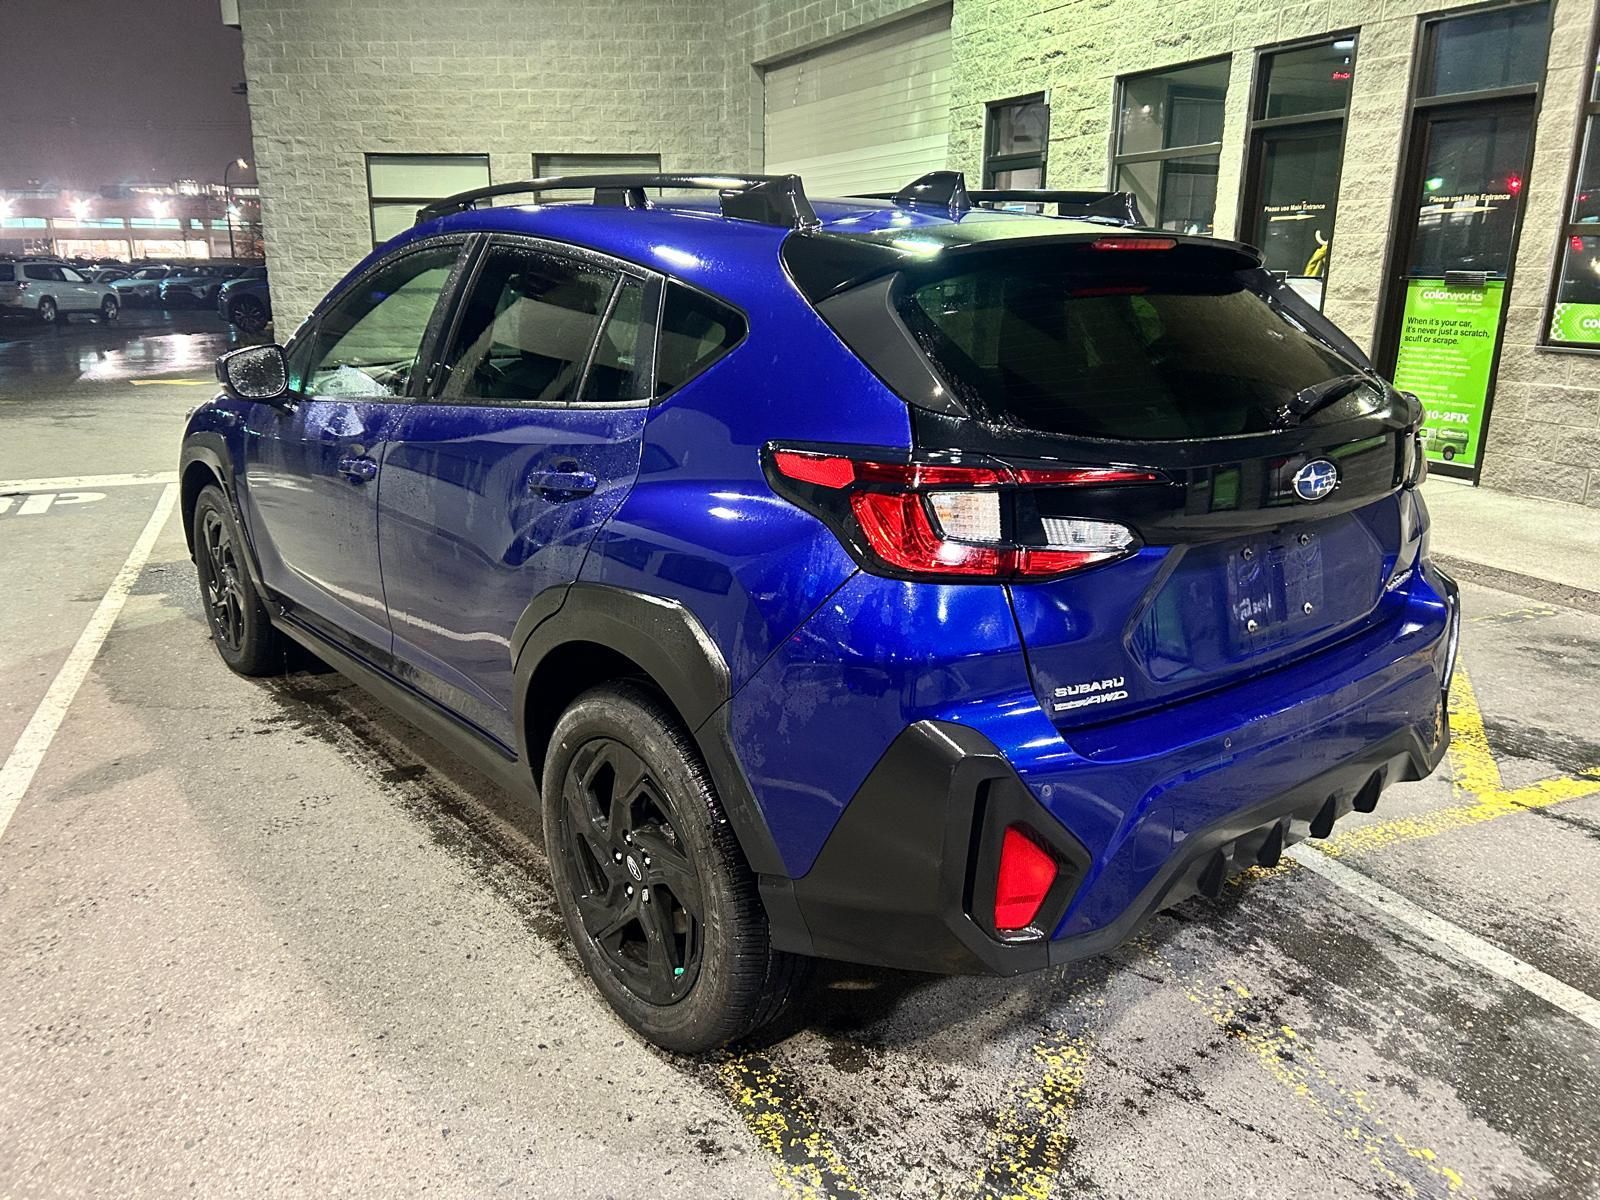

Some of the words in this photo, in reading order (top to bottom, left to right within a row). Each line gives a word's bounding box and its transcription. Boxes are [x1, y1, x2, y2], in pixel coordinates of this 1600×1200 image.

[1429, 195, 1450, 203] Please
[1481, 193, 1511, 201] Entrance
[1423, 289, 1483, 301] colorworks
[1408, 316, 1428, 325] When
[1429, 318, 1440, 326] it's
[1441, 319, 1458, 328] your
[1459, 320, 1473, 328] car,
[1418, 327, 1437, 335] never
[1438, 328, 1453, 336] just
[1460, 330, 1490, 338] scratch,
[1433, 337, 1460, 346] scrape.
[1054, 676, 1124, 697] SUBARU
